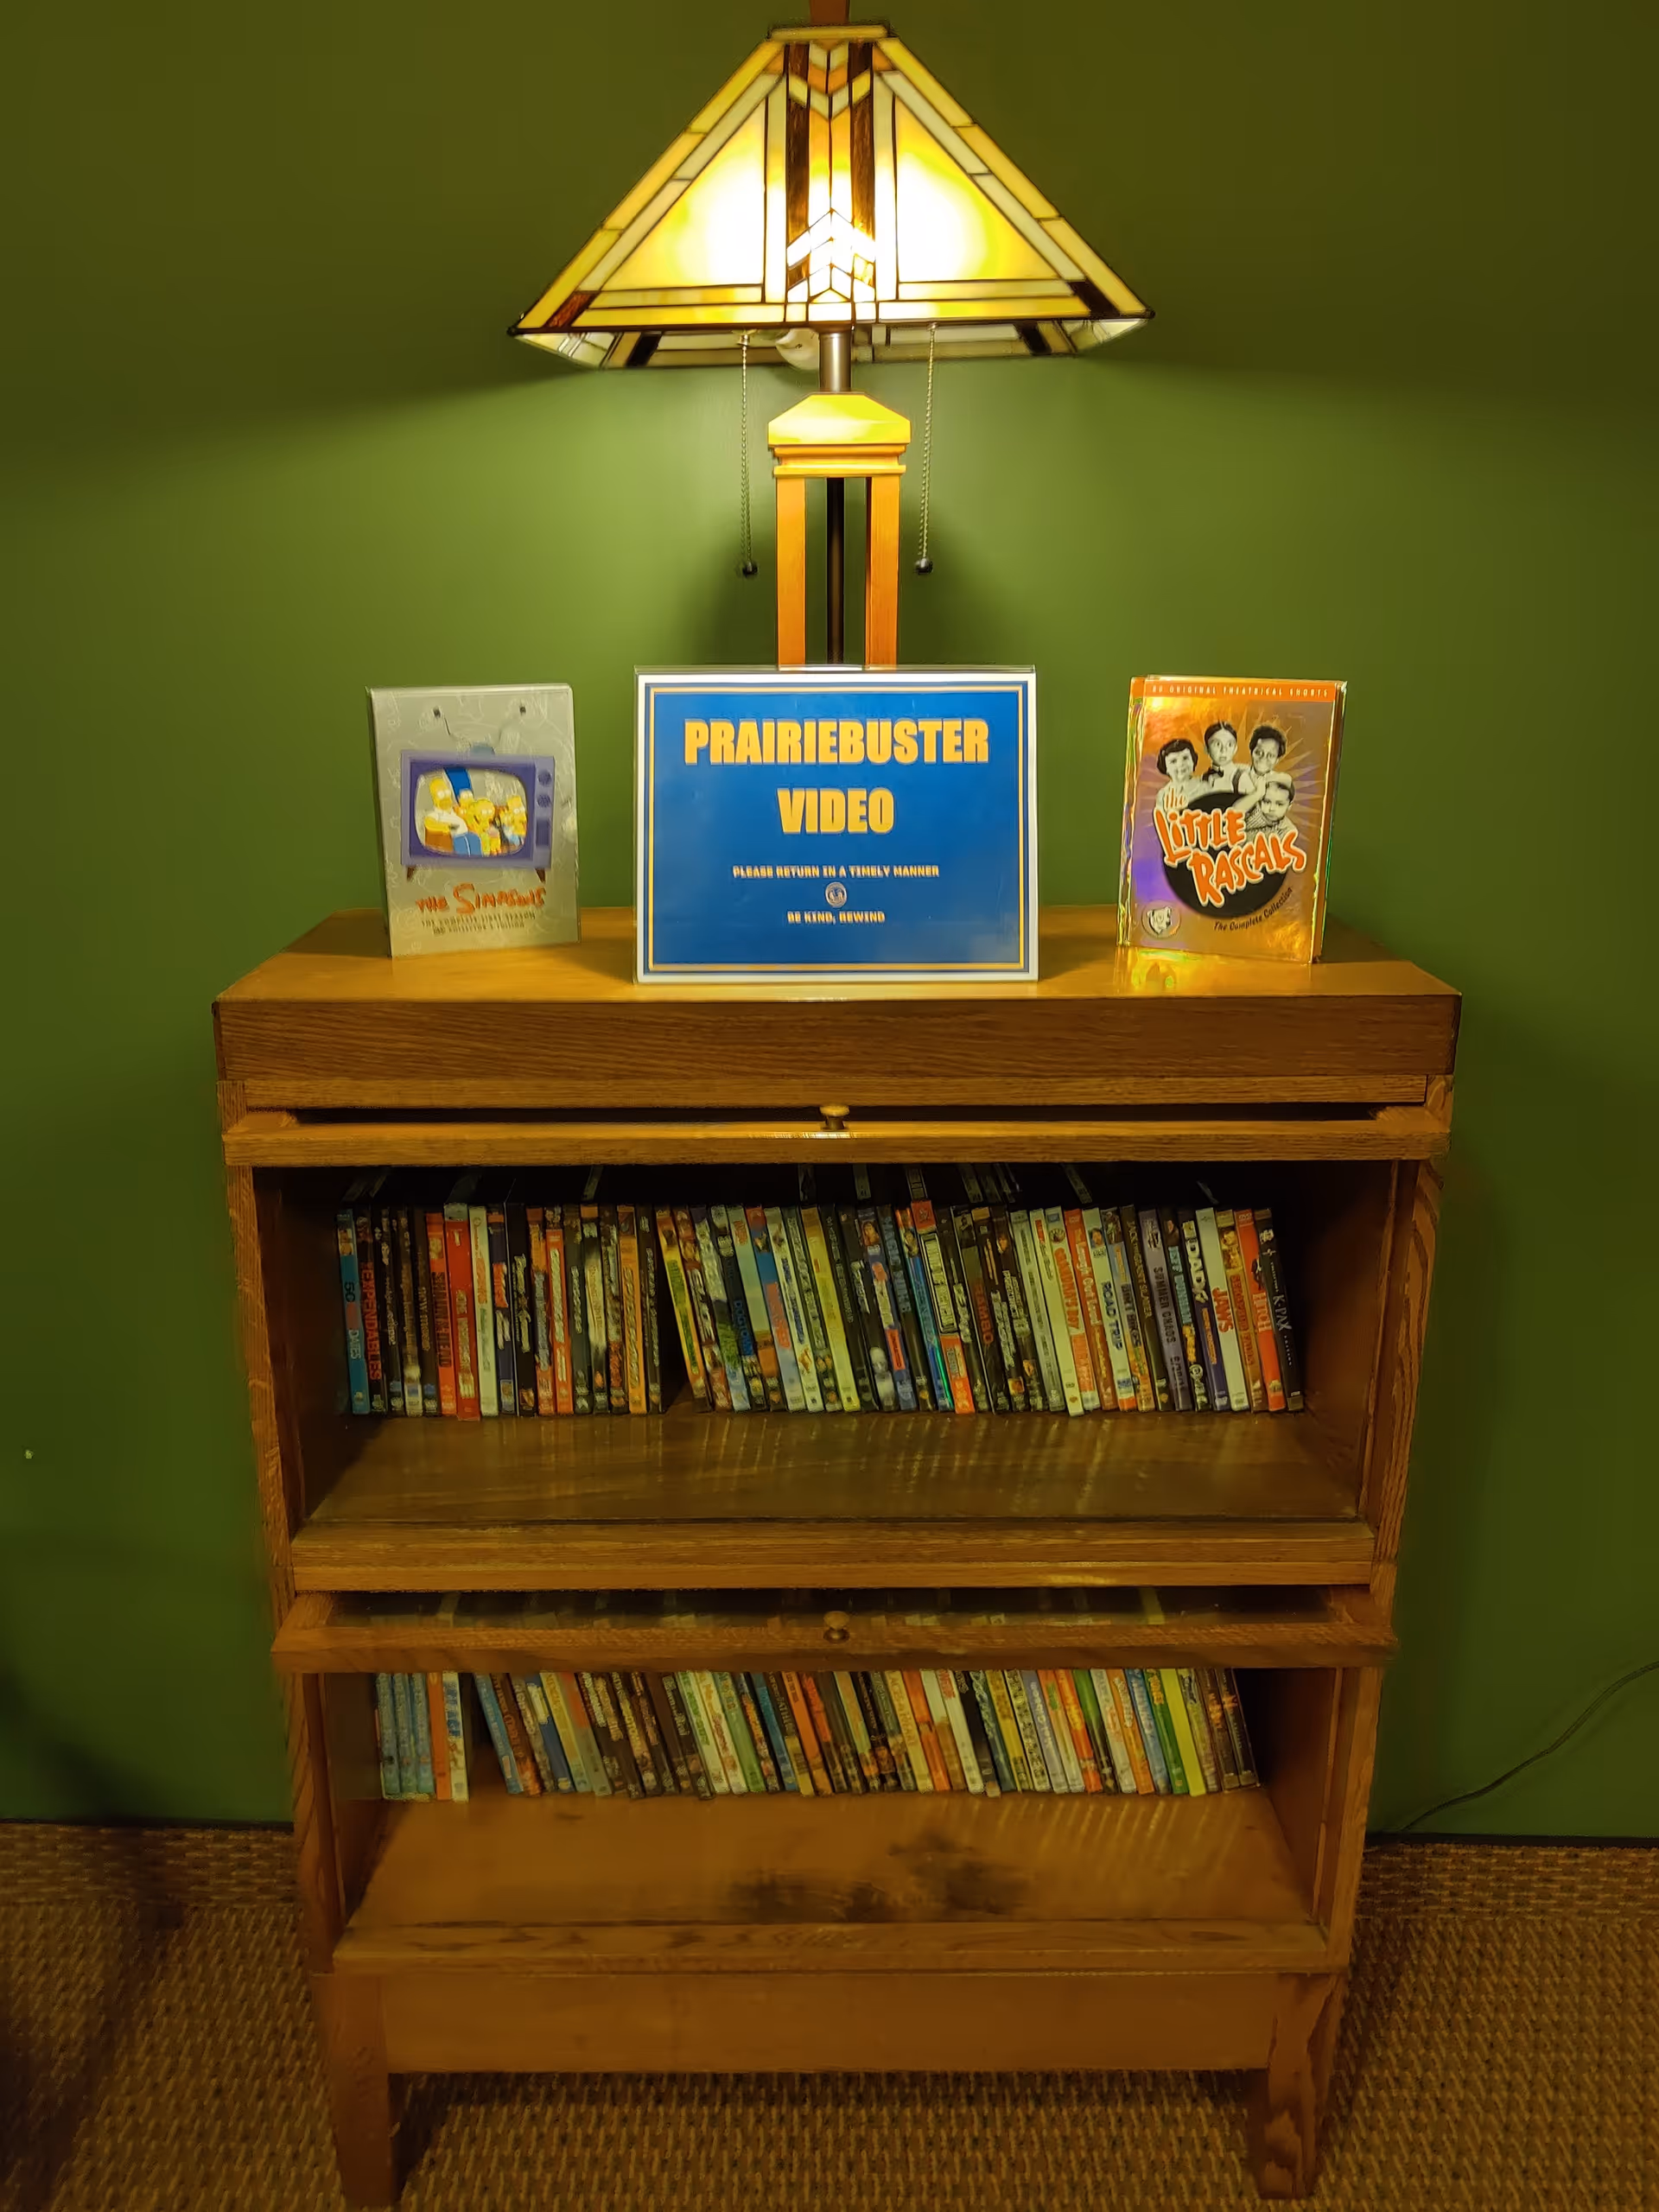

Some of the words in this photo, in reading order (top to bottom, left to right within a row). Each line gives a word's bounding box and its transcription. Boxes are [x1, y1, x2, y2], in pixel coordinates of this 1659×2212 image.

[684, 718, 989, 766] PRAIRIEBUSTER
[777, 787, 894, 834] VIDEO
[732, 865, 774, 879] PLEASE
[776, 865, 820, 878] RETURN
[822, 865, 837, 878] IN
[838, 865, 848, 878] A
[849, 865, 891, 878] TIMELY
[893, 865, 939, 878] MANNER
[1186, 830, 1307, 908] RASCALS
[786, 911, 802, 924] BE
[804, 911, 837, 925] KIND,
[838, 911, 886, 924] REWIND
[1213, 919, 1228, 931] The
[1229, 916, 1262, 931] Complete
[1263, 886, 1294, 918] Collection
[1102, 1281, 1117, 1318] ROAD
[1153, 1266, 1172, 1310] SUMMER
[360, 1268, 382, 1382] EXPENDABLES
[1161, 1311, 1177, 1344] CHAOS
[1212, 1287, 1234, 1333] JAWS
[1252, 1291, 1273, 1333] HITCH
[1272, 1294, 1293, 1332] K-PAX
[1108, 1320, 1123, 1351] TRIP
